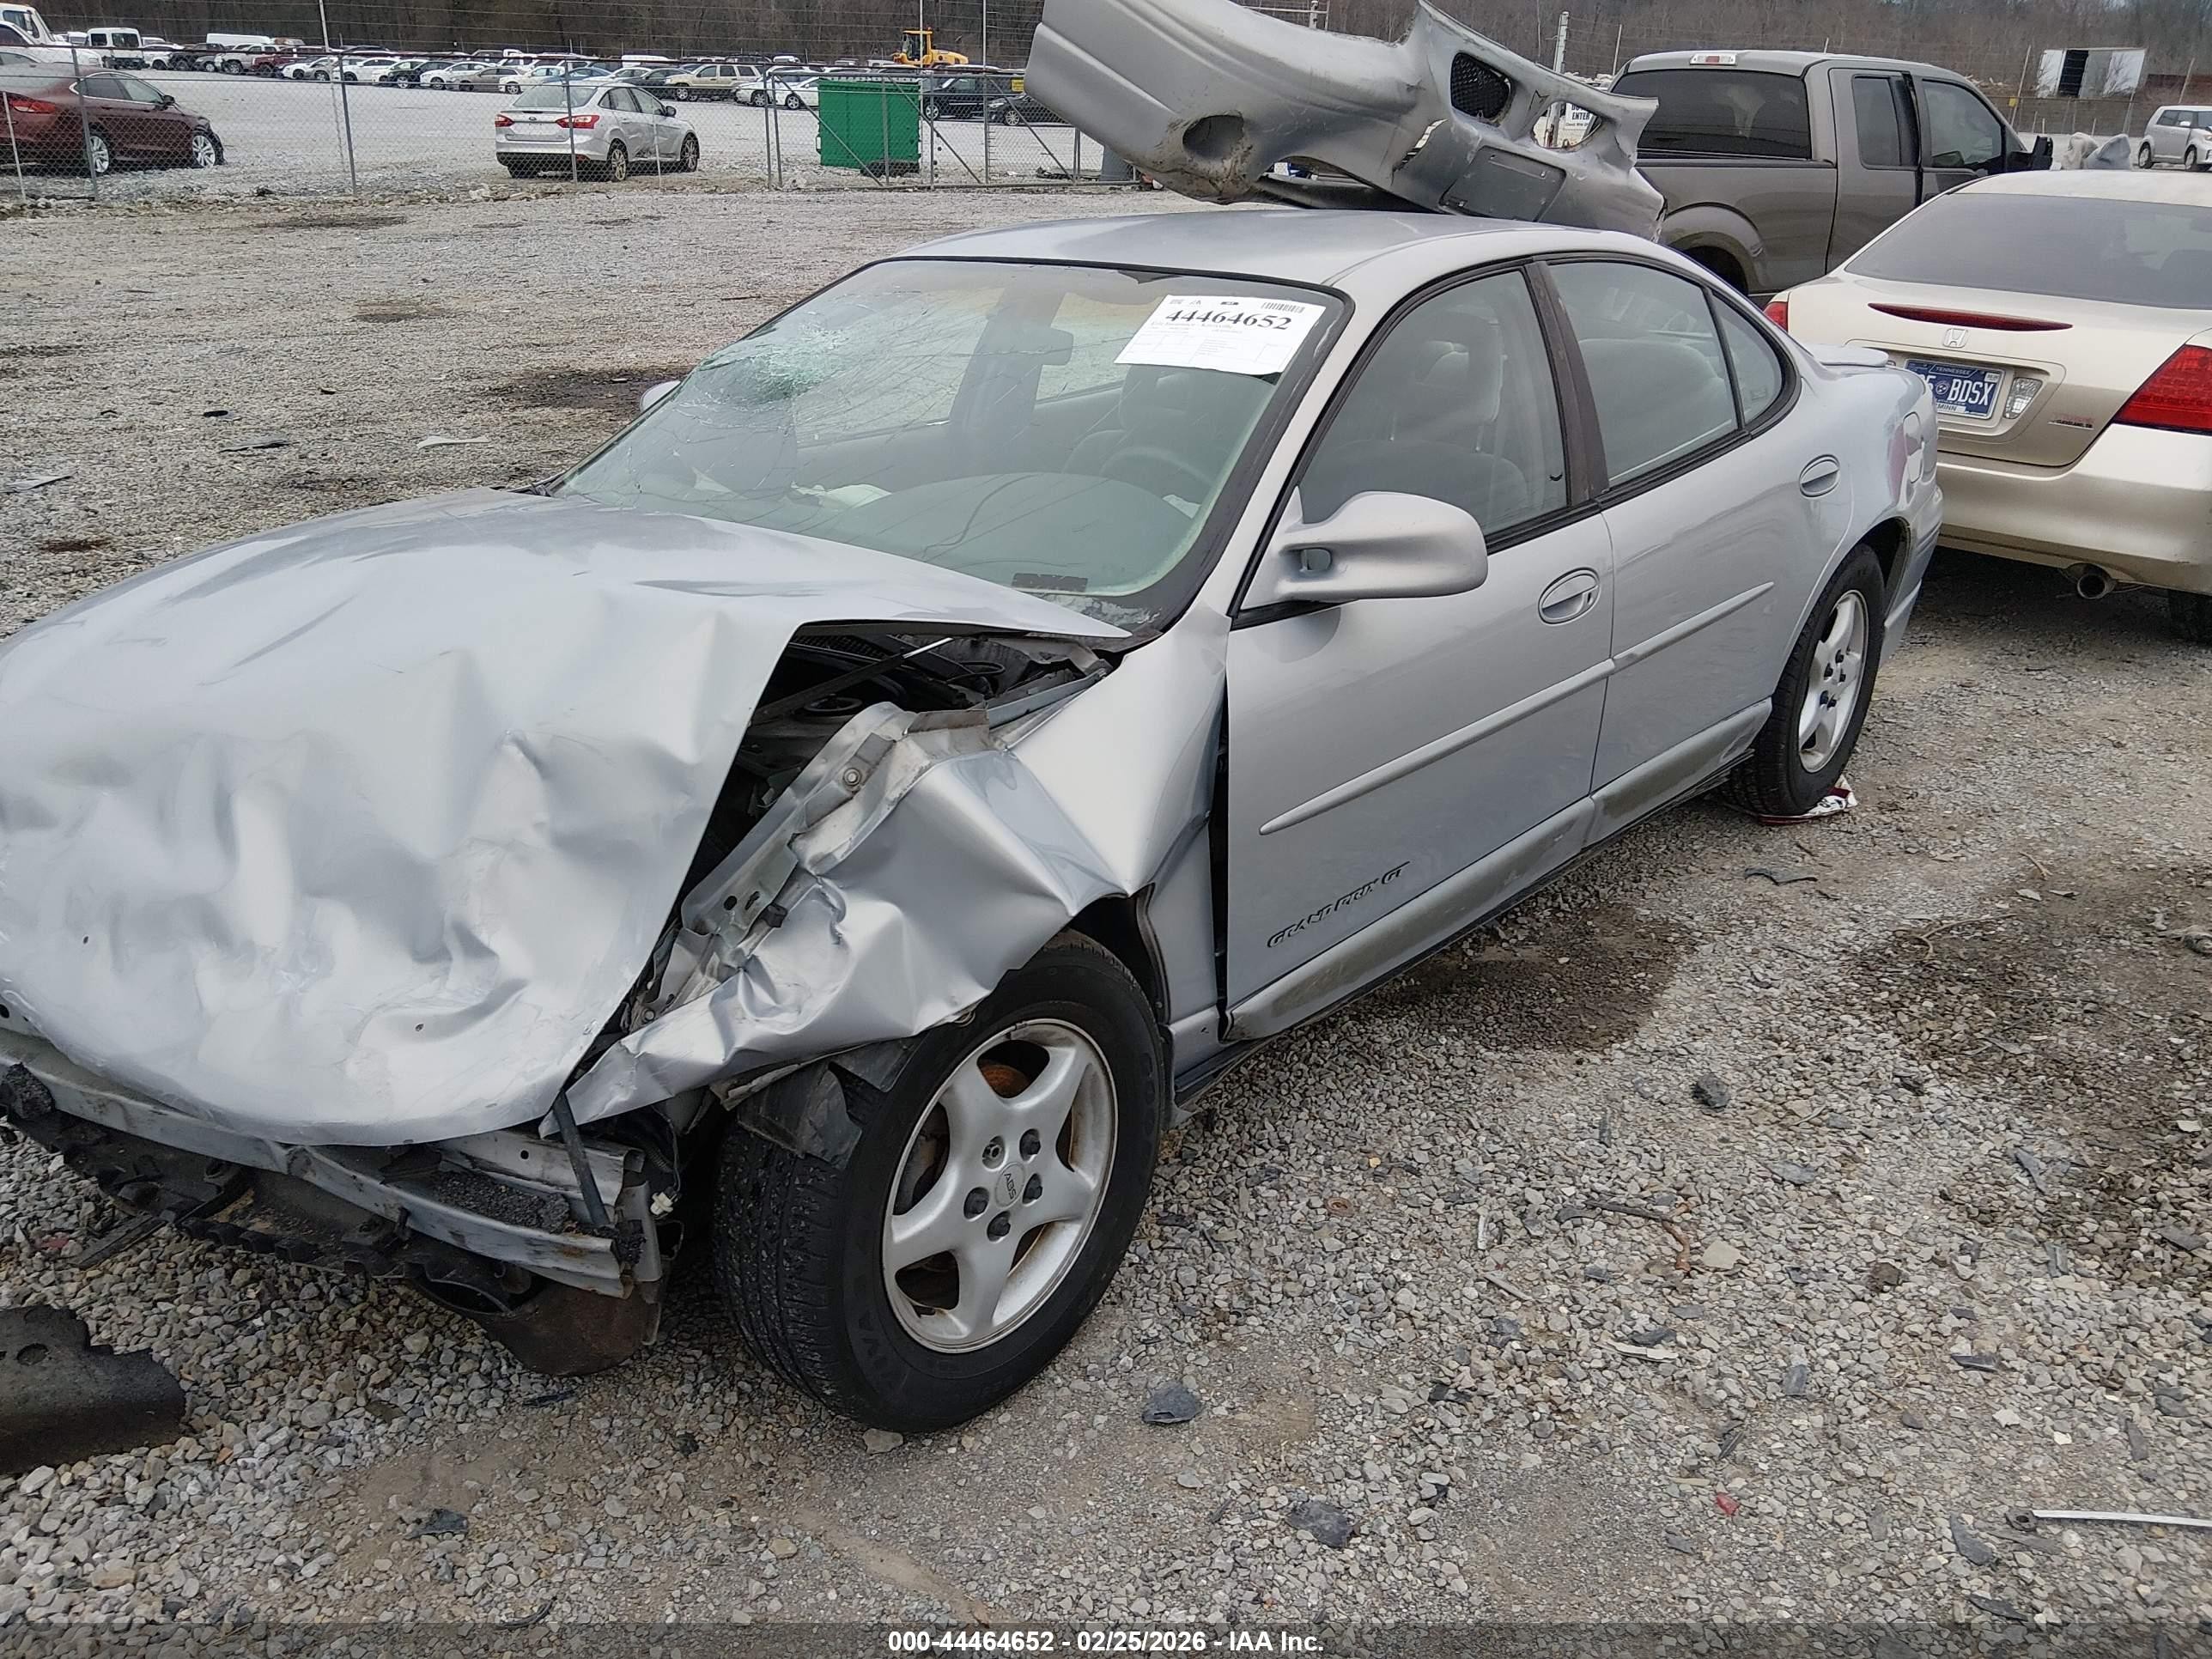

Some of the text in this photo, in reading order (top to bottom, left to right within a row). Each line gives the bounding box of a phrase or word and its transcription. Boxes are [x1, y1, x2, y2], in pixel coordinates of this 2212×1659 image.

[1571, 112, 1590, 120] ENTER
[1165, 310, 1291, 330] 44464652
[1936, 366, 1972, 375] TENNESSEE
[1947, 378, 1995, 405] BDSX
[1936, 403, 1958, 411] MINN
[1267, 861, 1410, 947] GRAND PRIX GT
[1004, 1173, 1017, 1200] ABS
